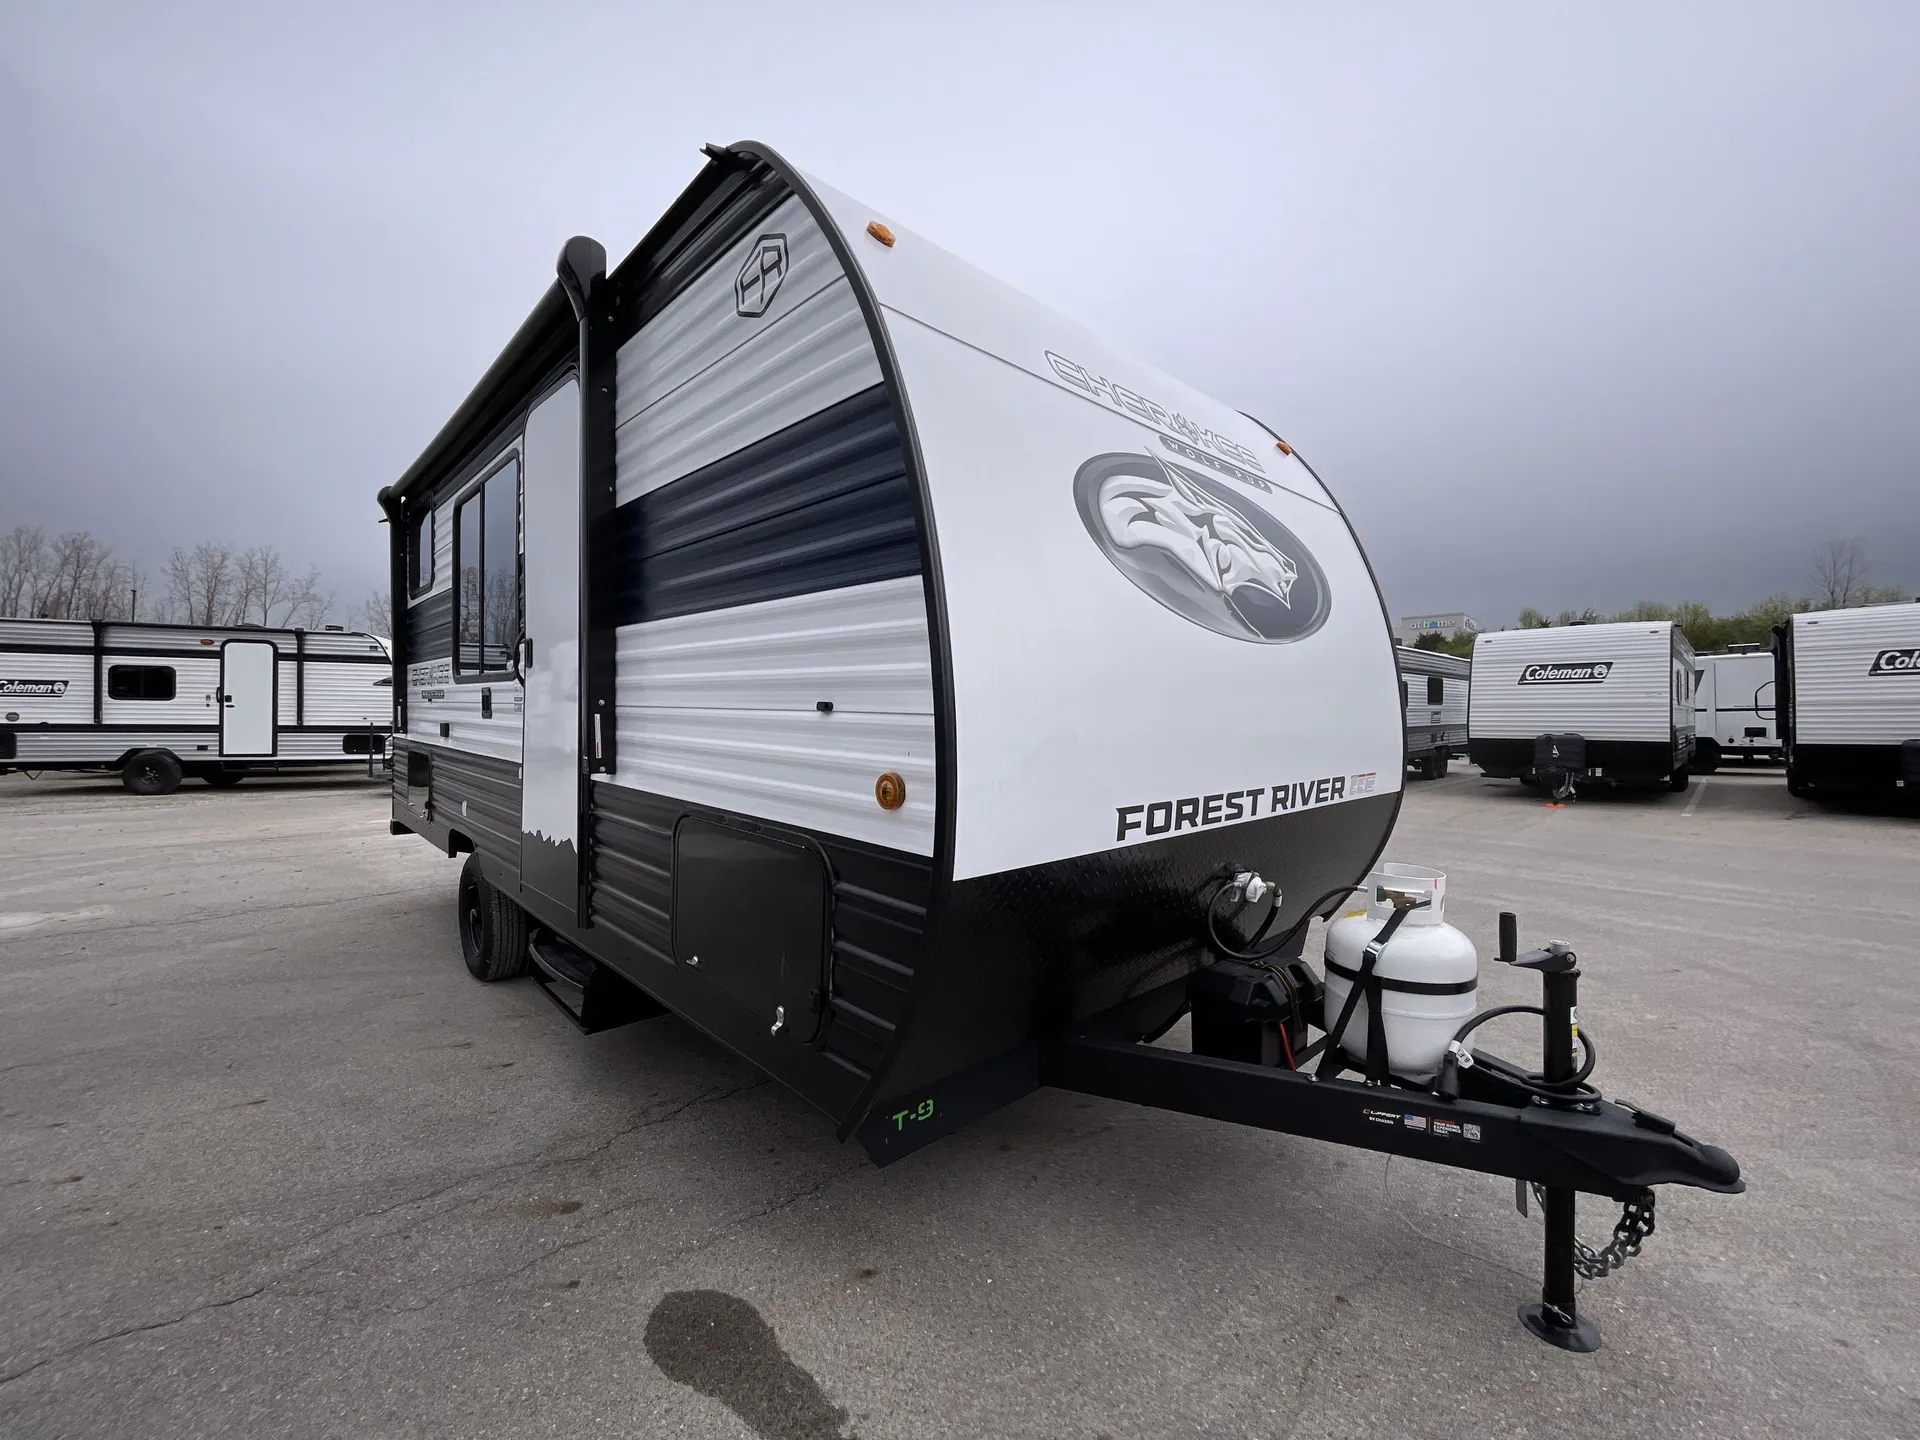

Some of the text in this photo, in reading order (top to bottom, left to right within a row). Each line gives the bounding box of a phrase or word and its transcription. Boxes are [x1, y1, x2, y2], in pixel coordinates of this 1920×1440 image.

[1168, 439, 1266, 489] WOLF PUP
[1410, 621, 1421, 630] at
[1525, 664, 1592, 680] Coleman
[1116, 787, 1265, 842] FOREST
[1271, 775, 1346, 813] RIVER
[892, 1099, 934, 1132] T-9
[1370, 1110, 1401, 1119] LIPPERT
